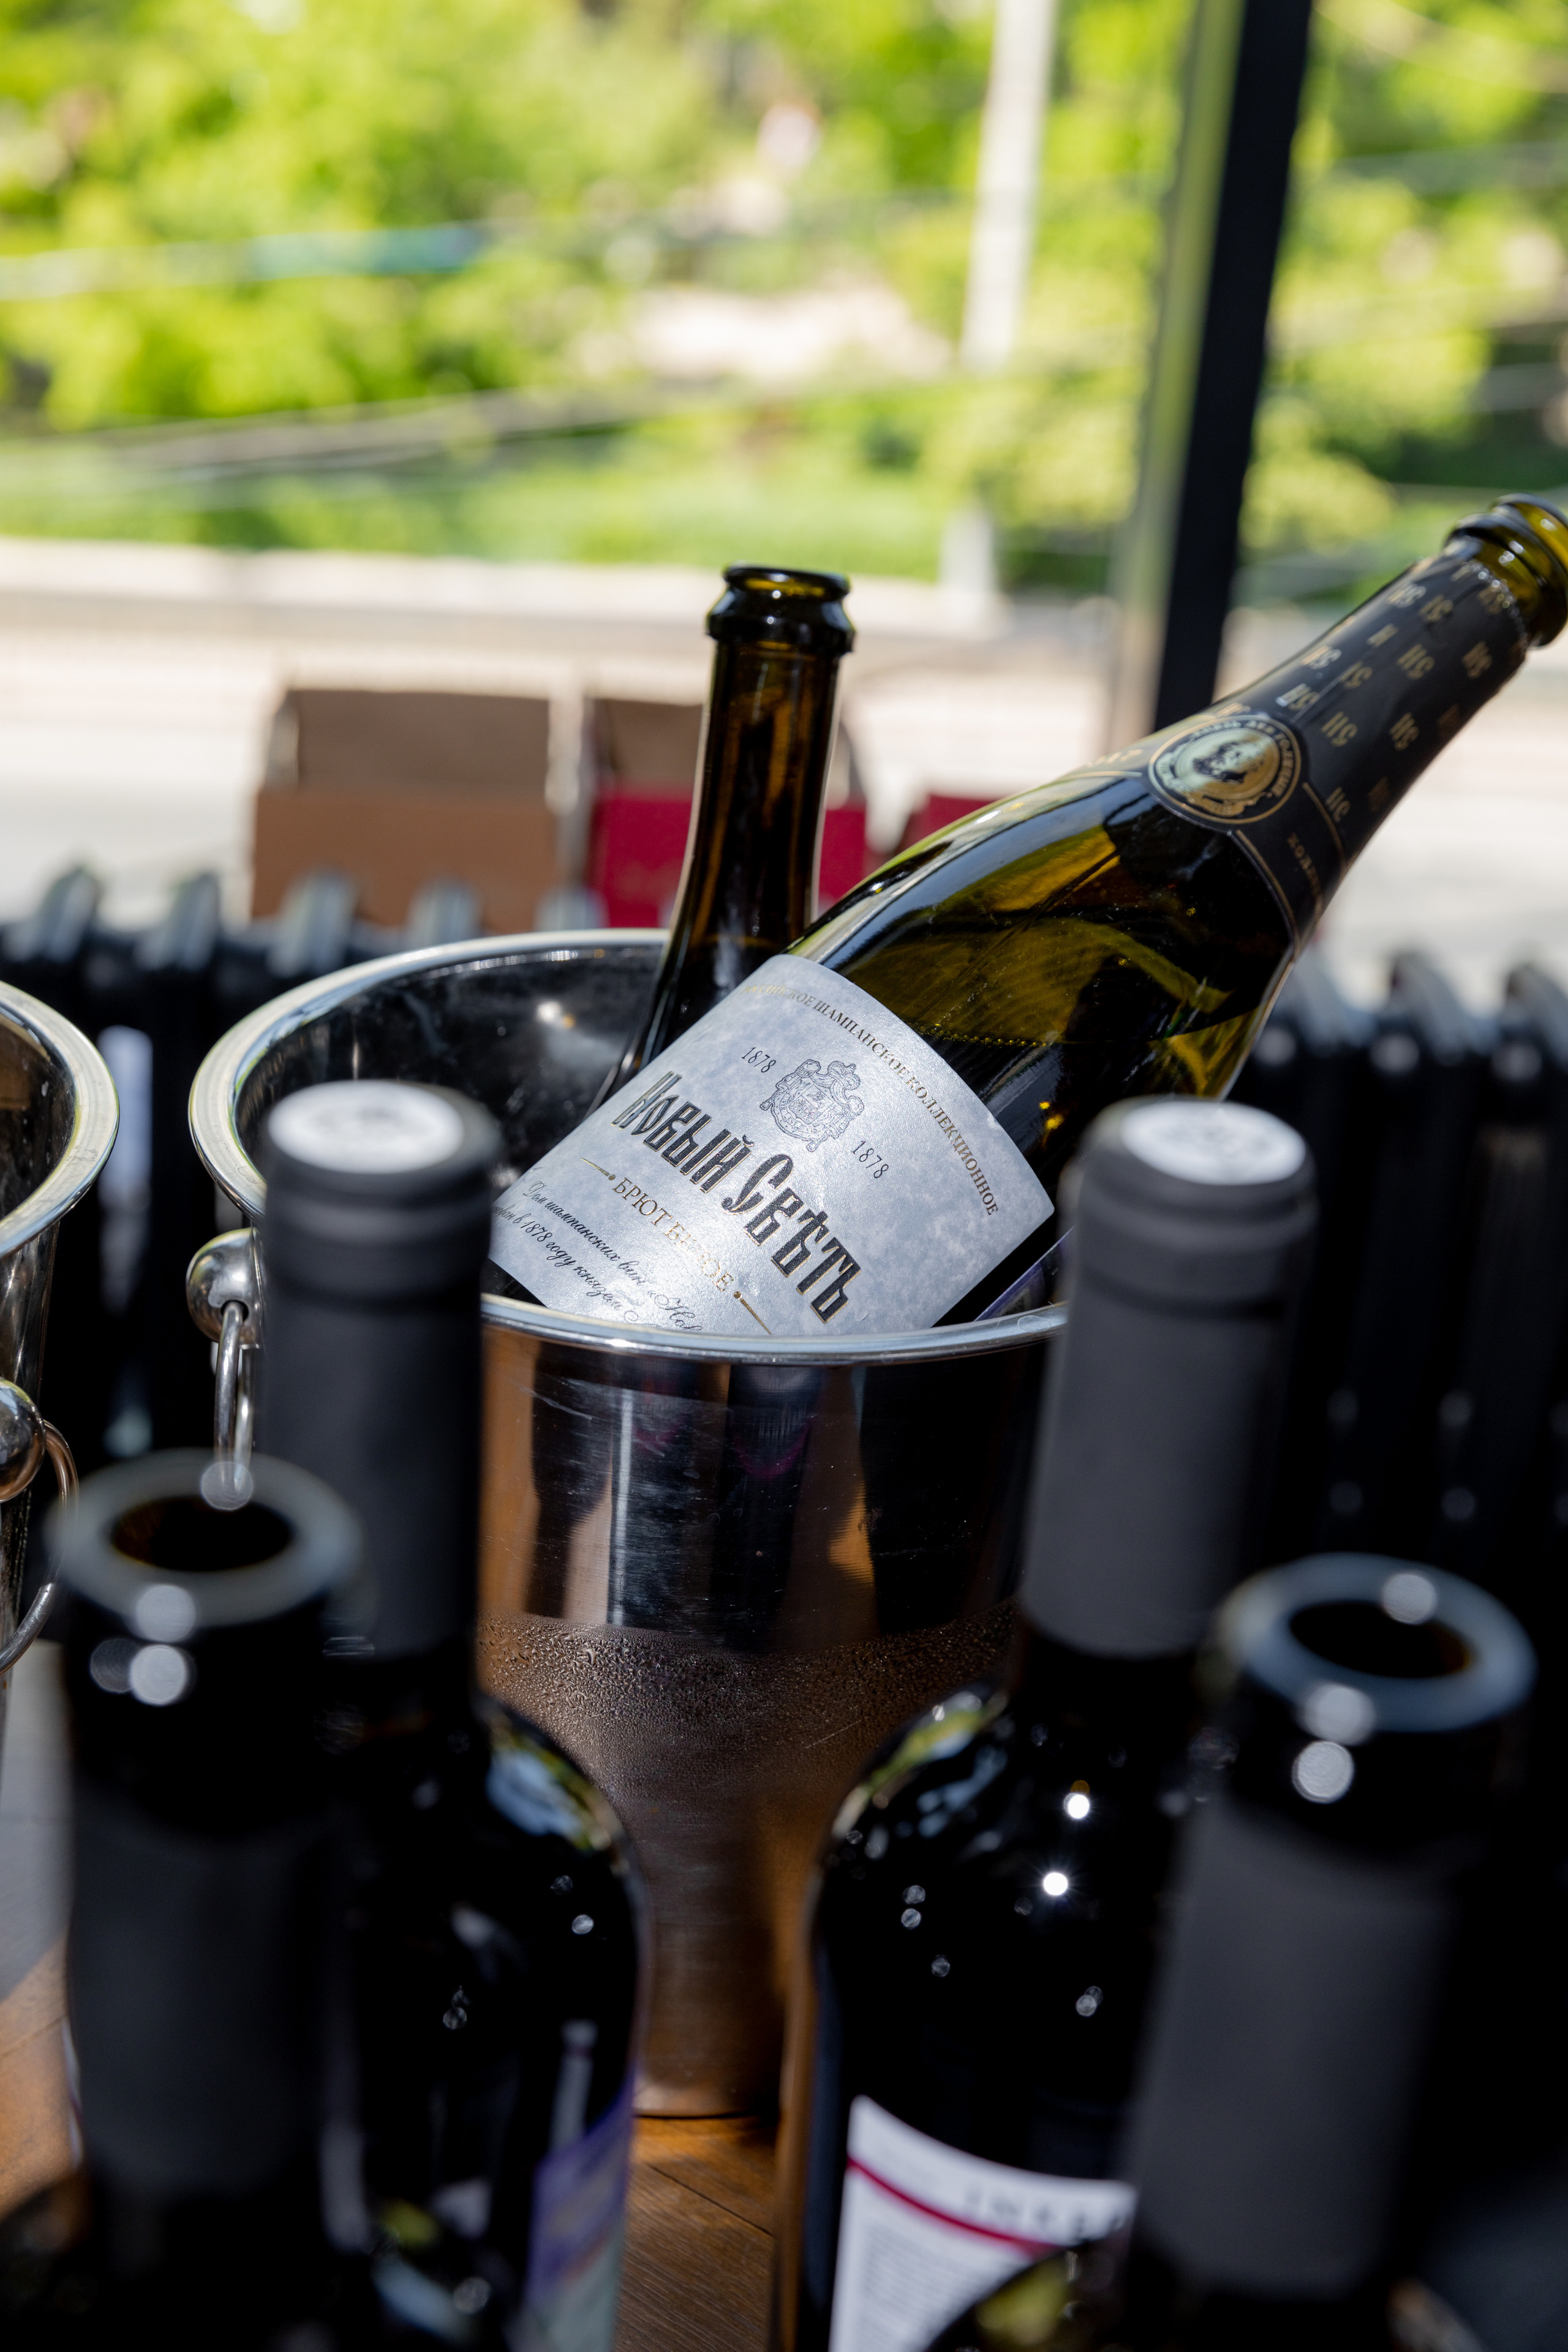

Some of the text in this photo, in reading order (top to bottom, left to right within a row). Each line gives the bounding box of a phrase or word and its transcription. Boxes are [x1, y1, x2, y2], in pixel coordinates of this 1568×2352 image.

[741, 1046, 889, 1179] 1878 1878
[813, 1000, 911, 1079] ШАМПАНСКОЕ
[905, 1076, 999, 1216] КОЛЛЕКЦИОННОЕ
[512, 1213, 532, 1224] в
[612, 1177, 673, 1226] БРЮТ
[519, 1220, 553, 1243] 1878
[522, 1181, 548, 1205] Дом
[544, 1201, 620, 1262] шампанских
[618, 1260, 647, 1287] вин
[546, 1242, 577, 1268] году
[572, 1265, 624, 1311] князем
